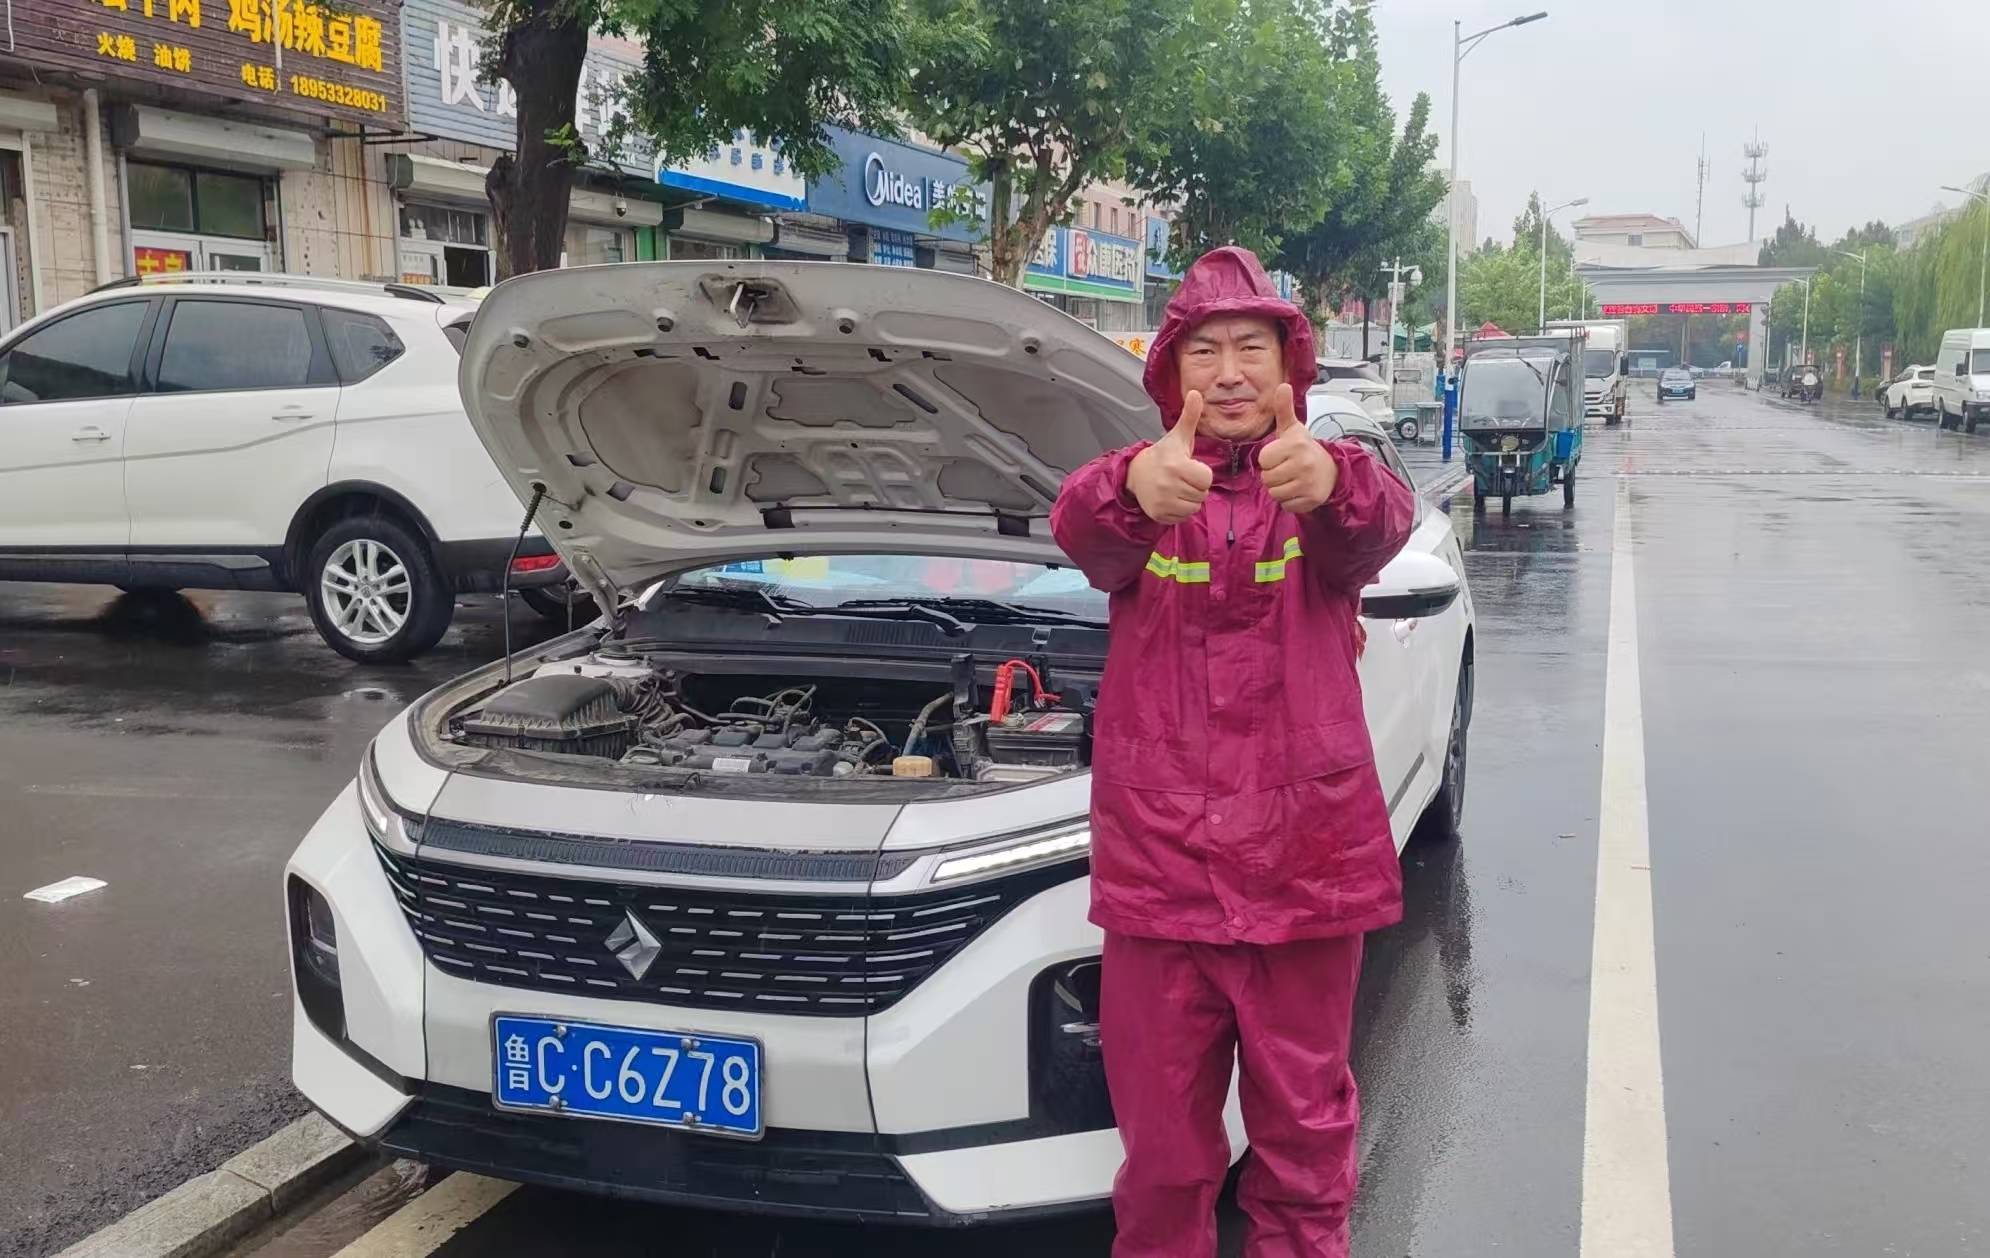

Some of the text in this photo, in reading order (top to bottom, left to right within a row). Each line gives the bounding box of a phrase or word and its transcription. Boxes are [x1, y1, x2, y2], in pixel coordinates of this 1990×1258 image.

[97, 31, 136, 62] 火烧
[153, 43, 192, 73] 油饼
[229, 0, 383, 72] 鸡汤辣豆腐
[290, 75, 386, 113] 18953328031
[865, 151, 922, 209] Midea
[504, 1033, 750, 1116] 鲁C·C6Z78
